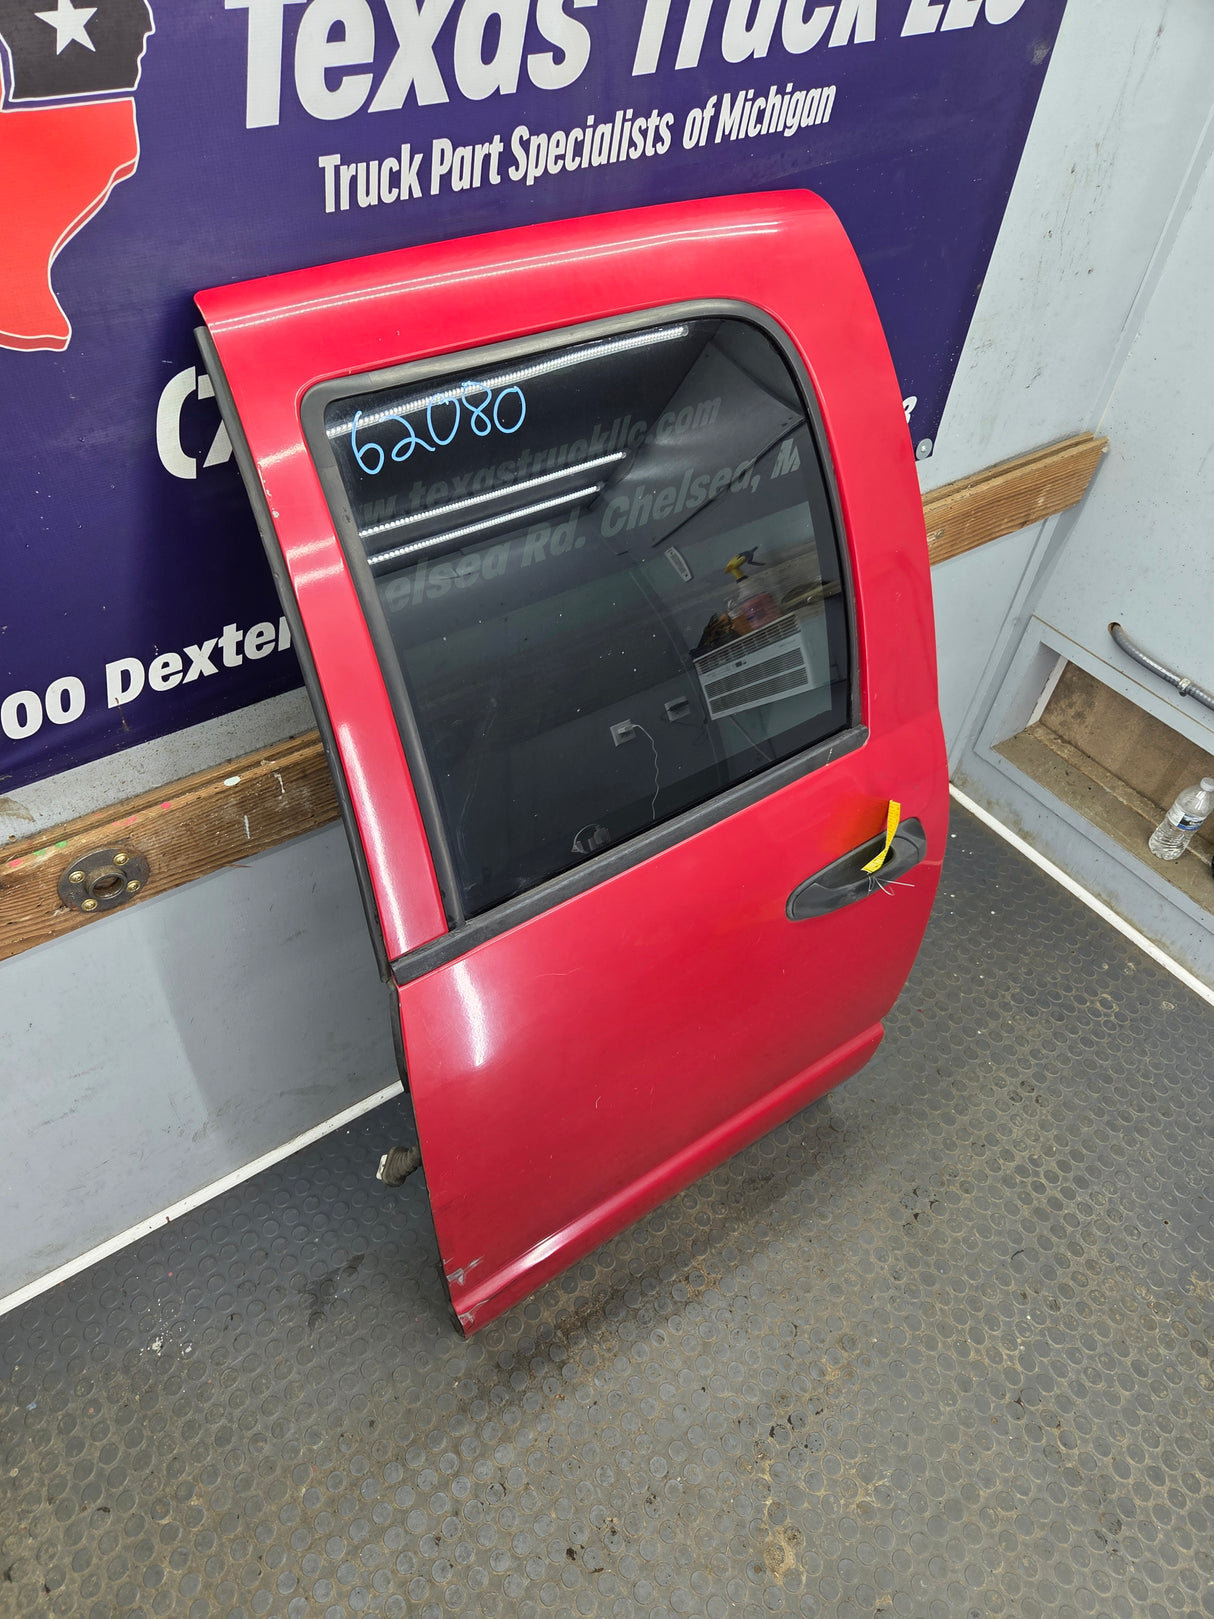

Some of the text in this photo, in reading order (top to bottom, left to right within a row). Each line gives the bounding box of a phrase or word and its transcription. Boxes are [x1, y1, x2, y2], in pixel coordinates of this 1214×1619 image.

[225, 0, 599, 129] Texas
[318, 82, 837, 214] Truck Part Specialists of Michigan
[351, 381, 527, 475] 62080
[521, 511, 586, 568] Rd.
[600, 457, 761, 537] Chelsea,
